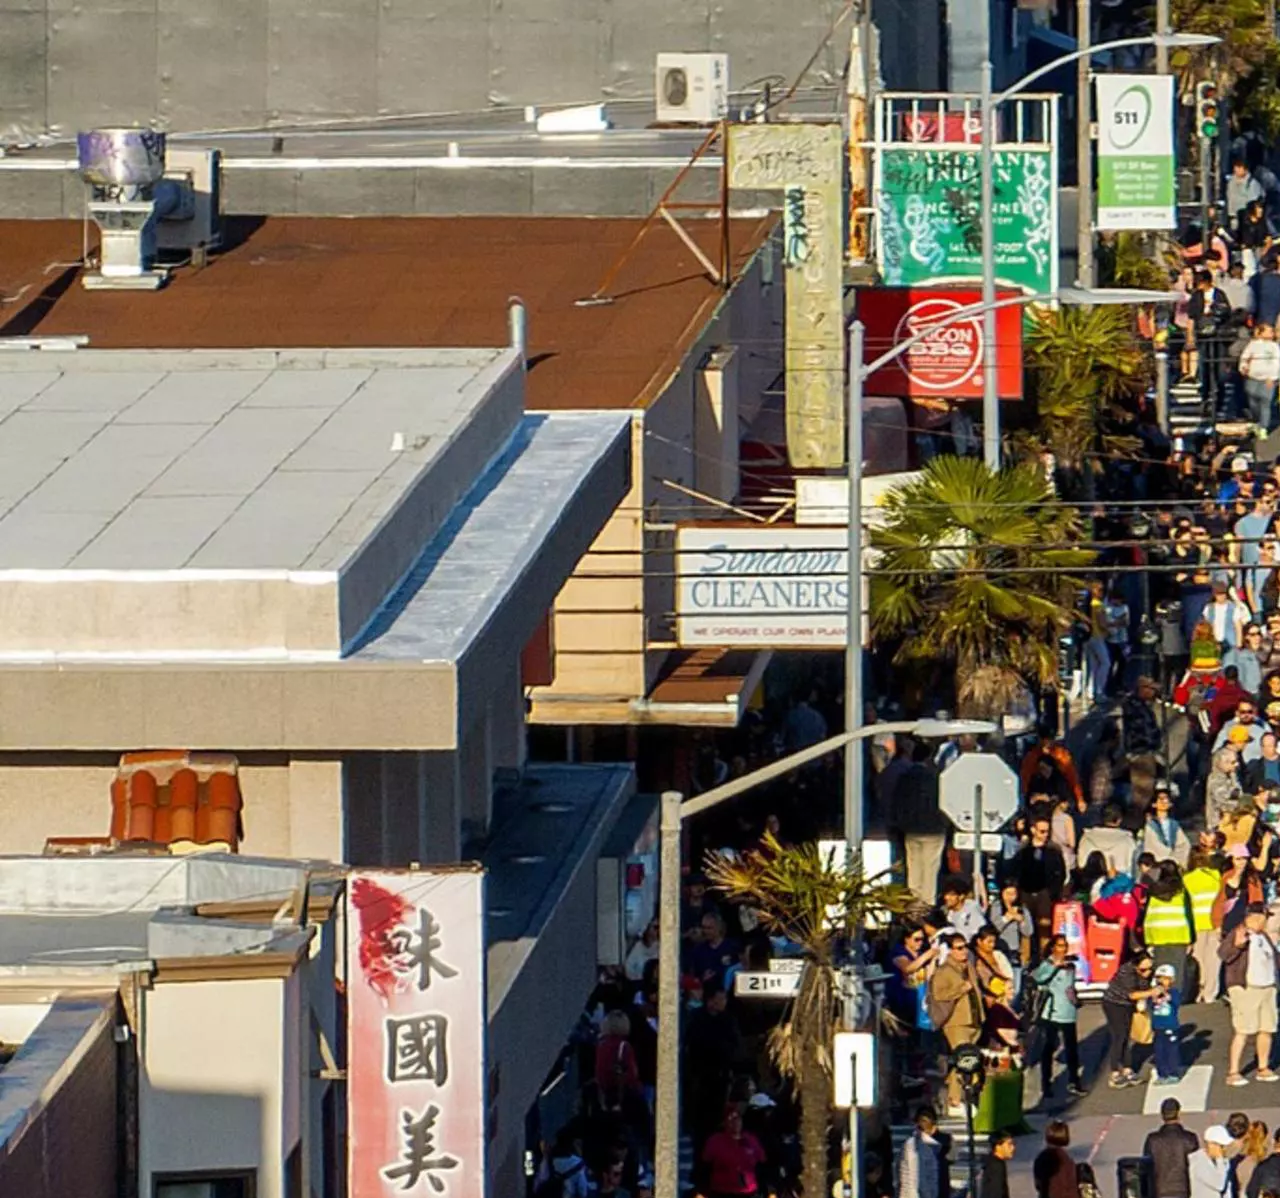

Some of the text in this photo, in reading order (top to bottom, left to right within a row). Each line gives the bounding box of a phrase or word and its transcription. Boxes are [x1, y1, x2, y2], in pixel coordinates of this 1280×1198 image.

[1114, 111, 1138, 124] 511
[701, 544, 842, 573] Sundown
[691, 580, 849, 608] CLEANERS
[693, 627, 848, 636] WE OPERATE OUR OWN PLAN
[749, 977, 782, 991] 21st
